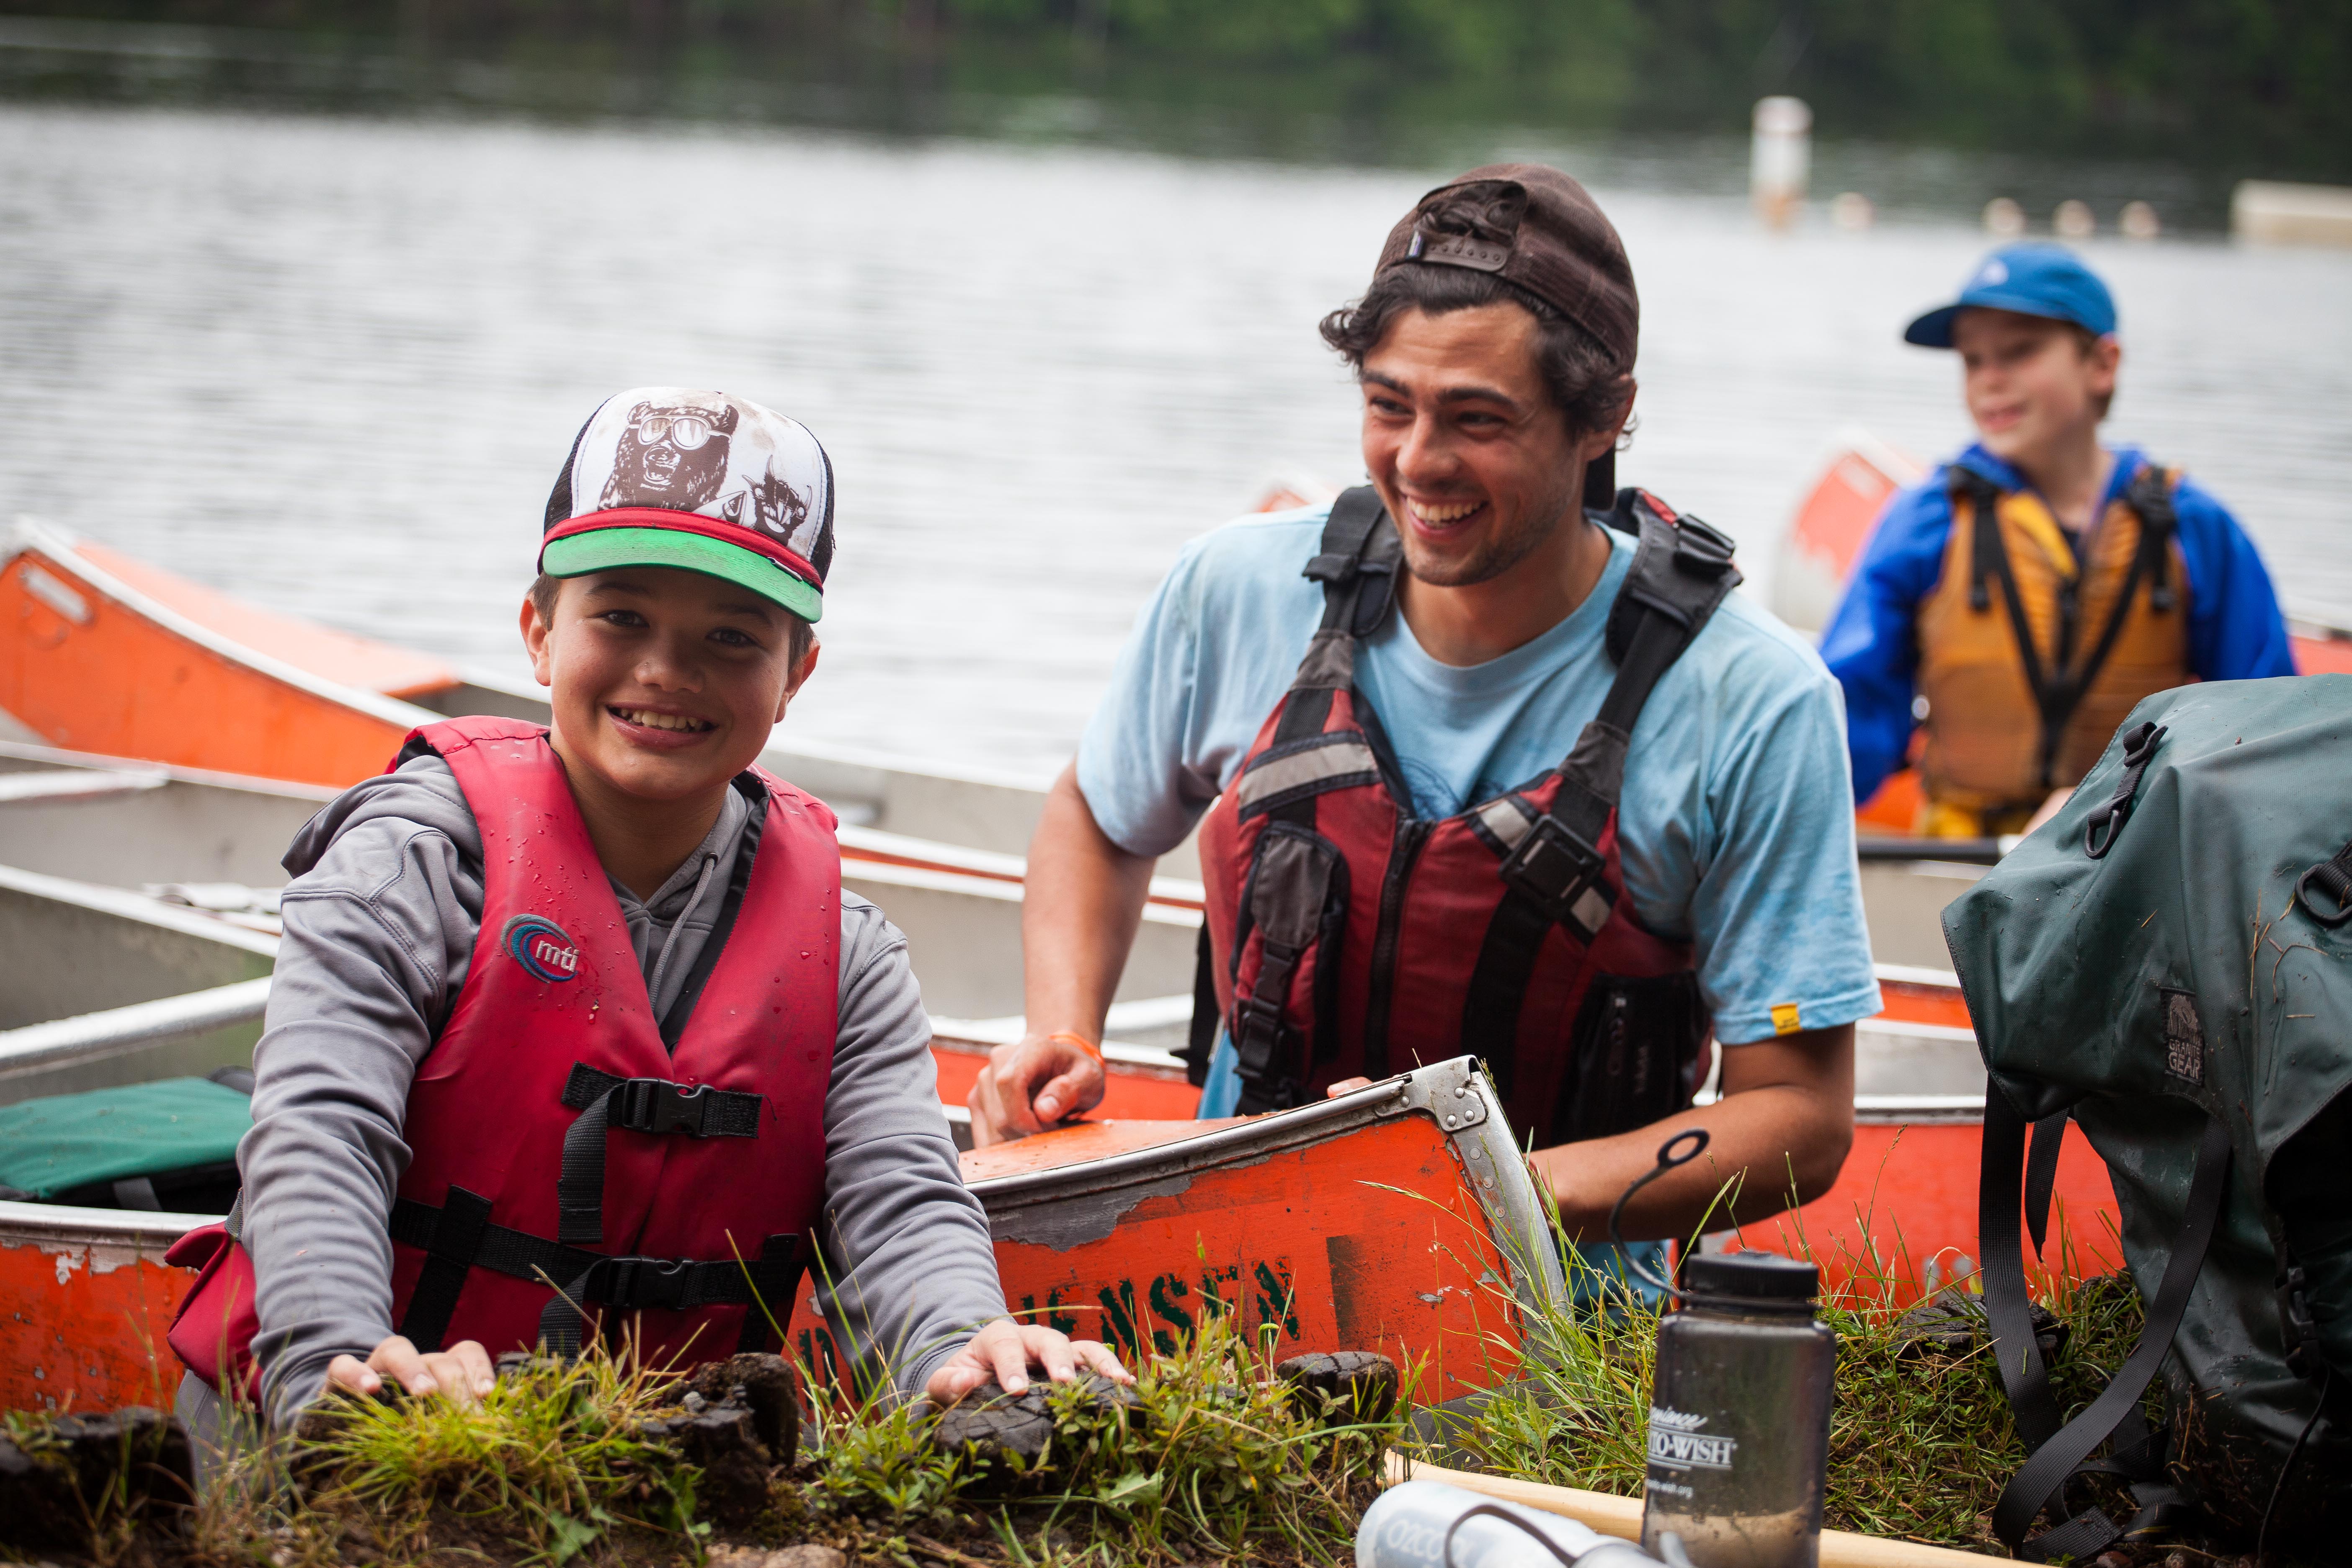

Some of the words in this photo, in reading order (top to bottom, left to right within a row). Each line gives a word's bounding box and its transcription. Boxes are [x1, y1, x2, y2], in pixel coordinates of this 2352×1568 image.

[536, 940, 580, 972] mti
[2169, 1039, 2202, 1060] GRANITE
[2169, 1052, 2200, 1079] GEAR
